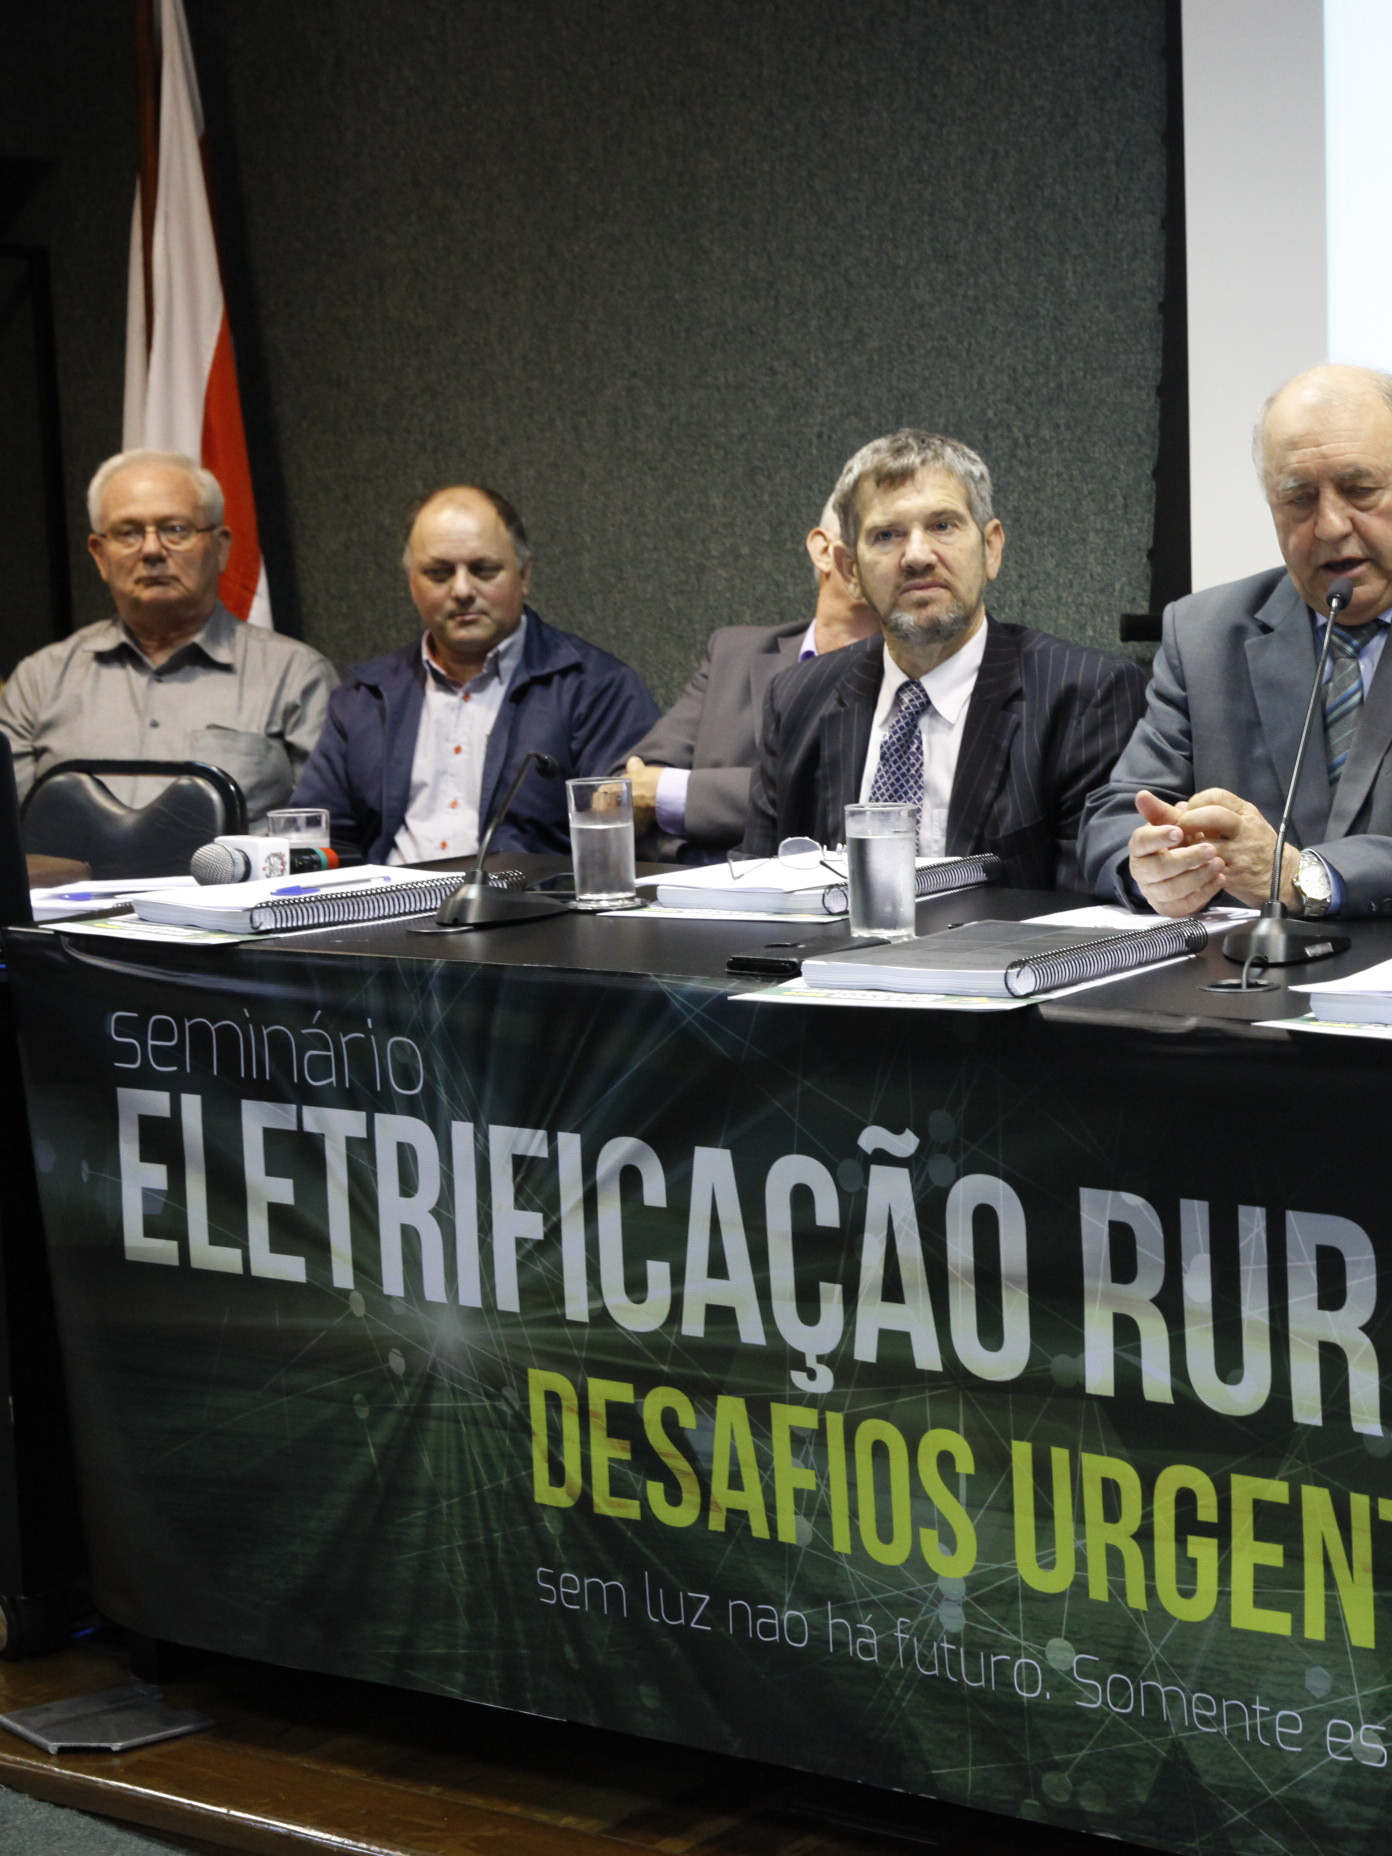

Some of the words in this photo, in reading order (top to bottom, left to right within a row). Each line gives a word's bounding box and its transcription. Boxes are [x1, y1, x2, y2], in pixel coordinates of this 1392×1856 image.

[110, 1009, 425, 1095] seminário
[115, 1086, 1031, 1394] ELETRIFICAÇÃO
[527, 1367, 978, 1580] DESAFIOS
[536, 1567, 627, 1618] sem
[644, 1570, 712, 1630] luz
[728, 1599, 808, 1648] nao
[827, 1600, 878, 1663] há
[893, 1617, 1051, 1700] futuro.
[1073, 1653, 1303, 1752] Somente
